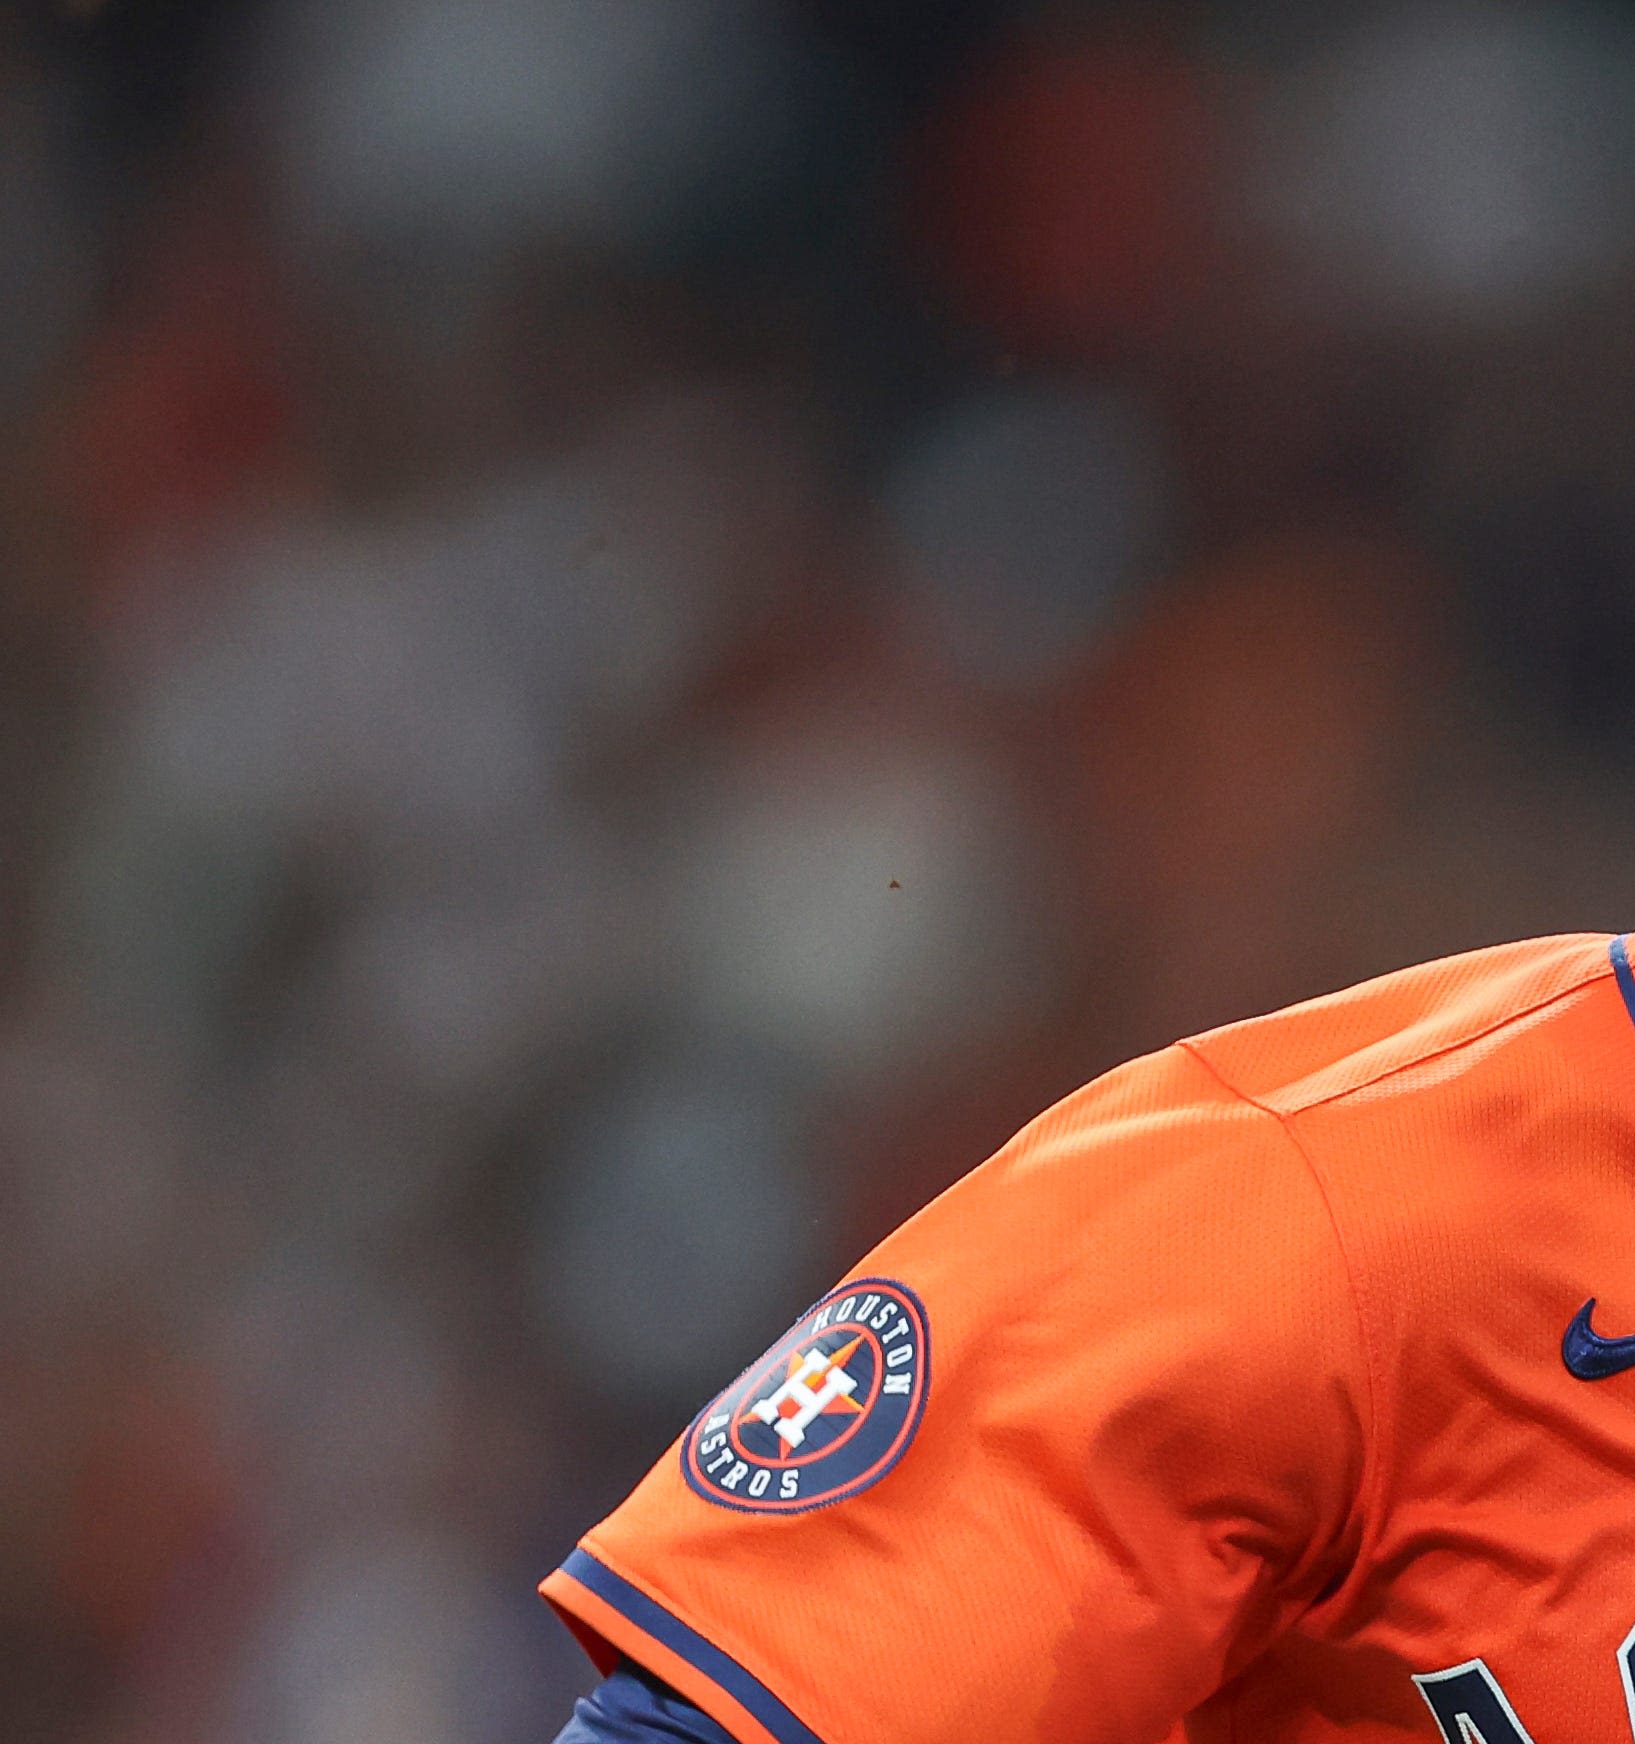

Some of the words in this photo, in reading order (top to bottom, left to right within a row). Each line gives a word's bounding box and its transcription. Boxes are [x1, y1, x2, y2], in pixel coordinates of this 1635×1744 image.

[811, 1294, 913, 1395] HOUSTON
[751, 1348, 857, 1448] H
[701, 1413, 799, 1498] ASTROS
